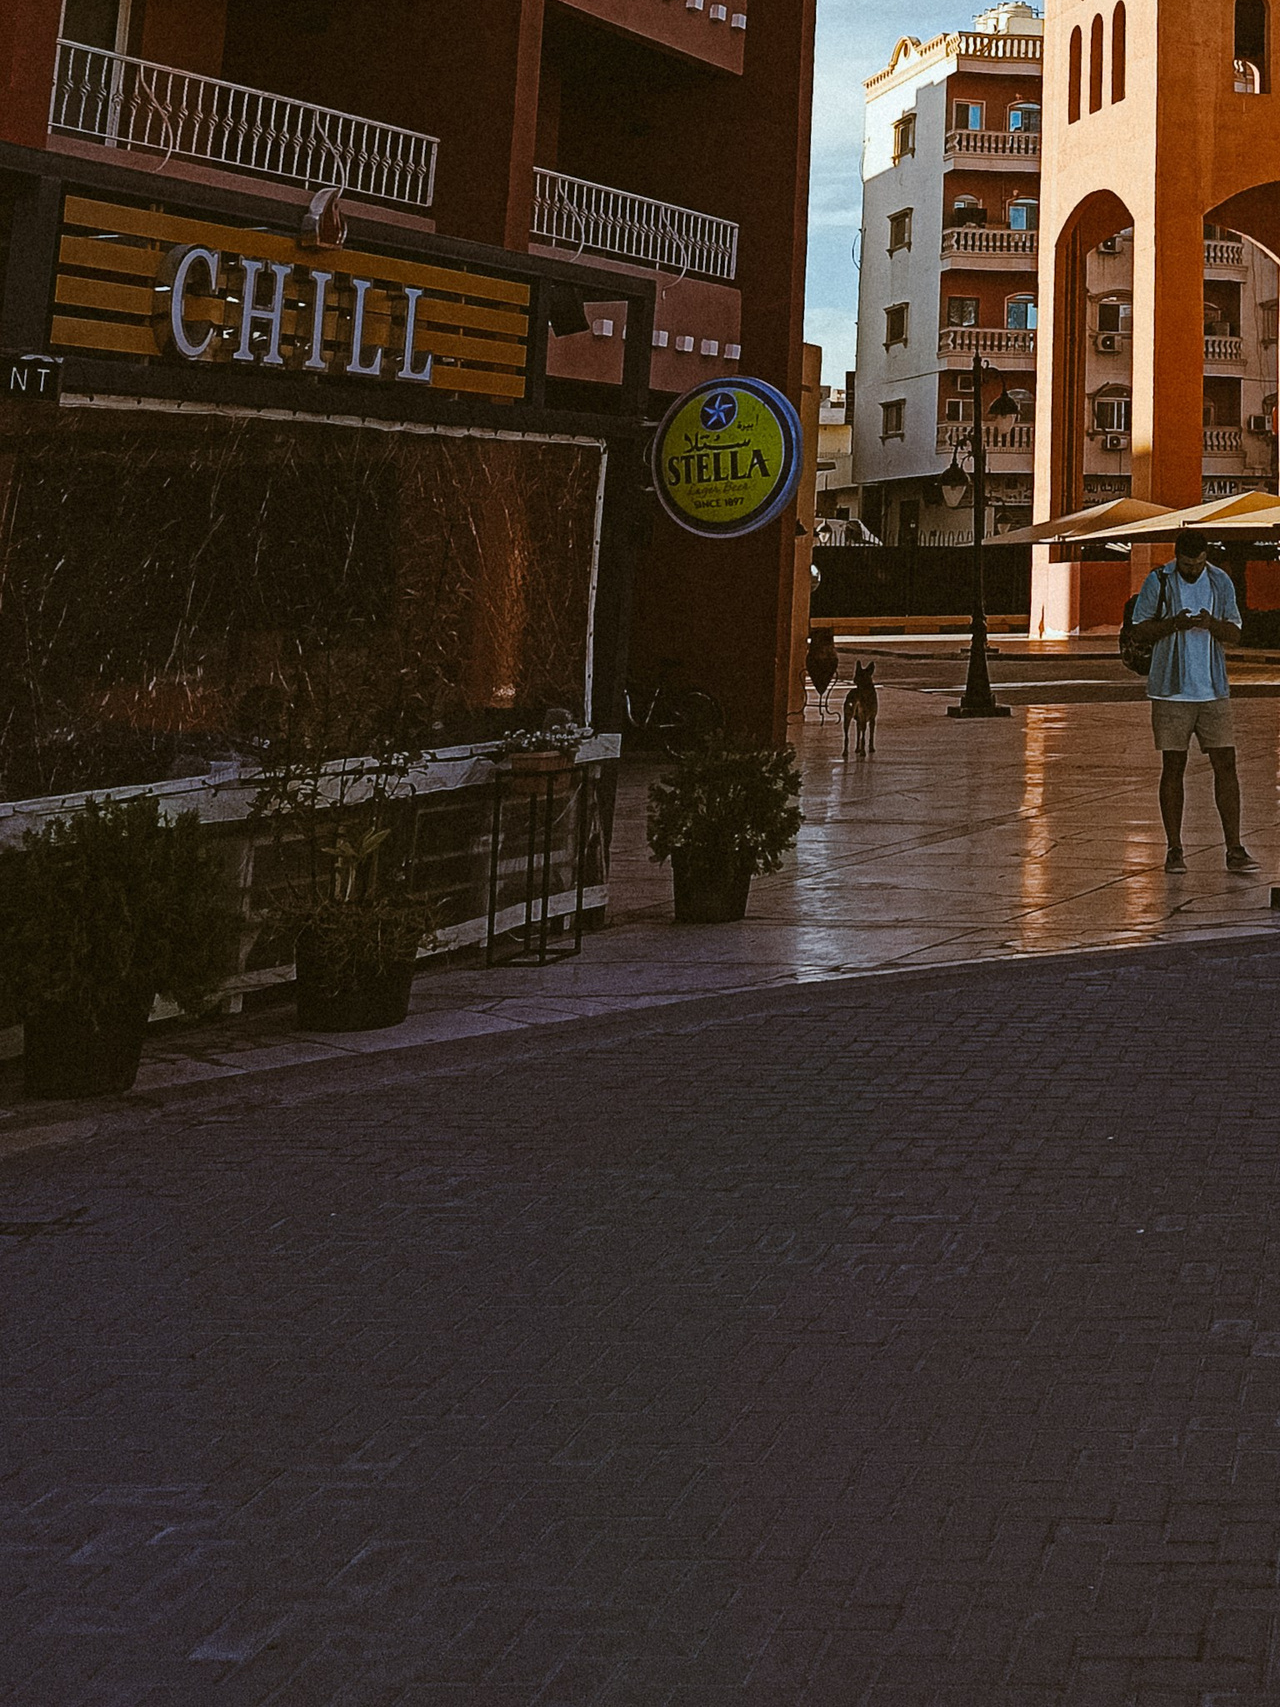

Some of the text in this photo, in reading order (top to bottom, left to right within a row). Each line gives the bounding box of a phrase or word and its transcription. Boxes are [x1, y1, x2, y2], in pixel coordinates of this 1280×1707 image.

[168, 246, 433, 382] CHILL
[667, 449, 771, 487] STELLA
[723, 480, 750, 493] Beer
[694, 497, 745, 509] SINCE 1897
